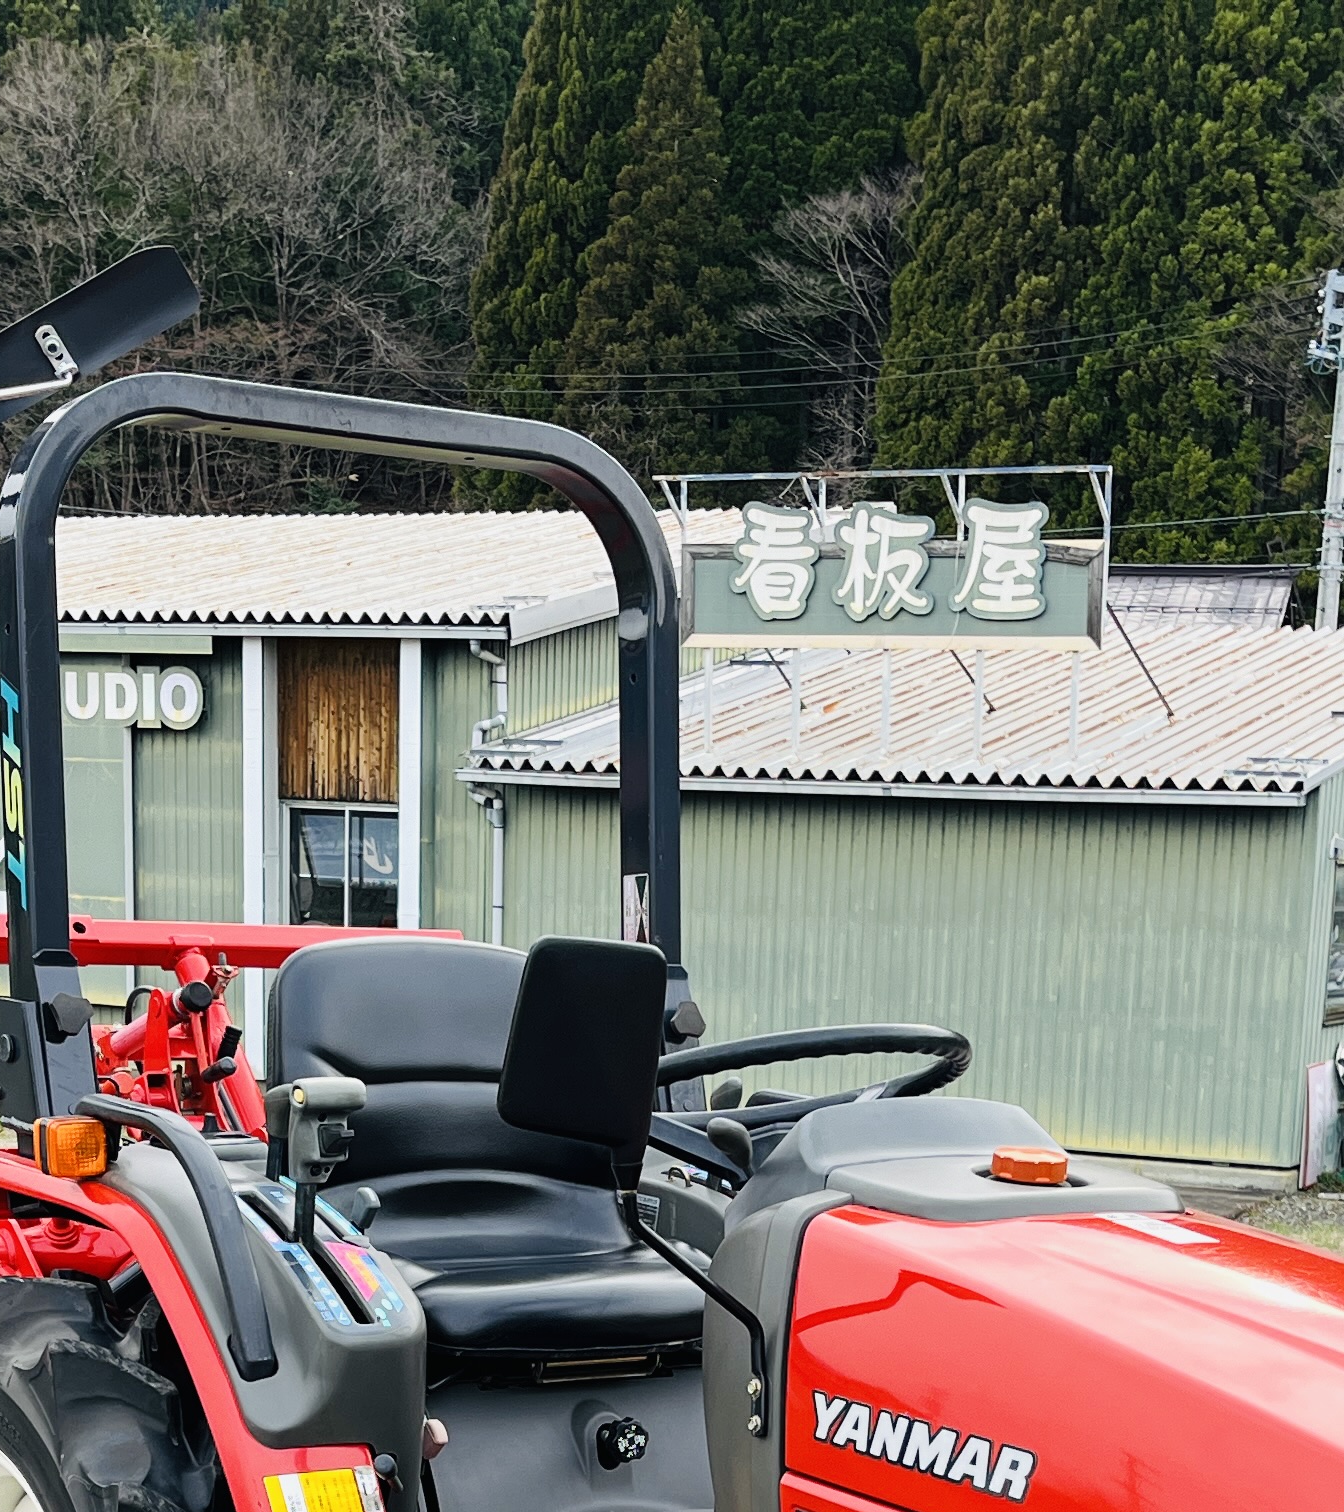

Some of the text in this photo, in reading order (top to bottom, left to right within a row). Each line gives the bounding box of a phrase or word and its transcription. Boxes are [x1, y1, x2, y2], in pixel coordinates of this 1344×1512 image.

[732, 504, 1045, 616] 看板屋
[0, 676, 28, 912] HST
[812, 1390, 1037, 1503] YANMAR
